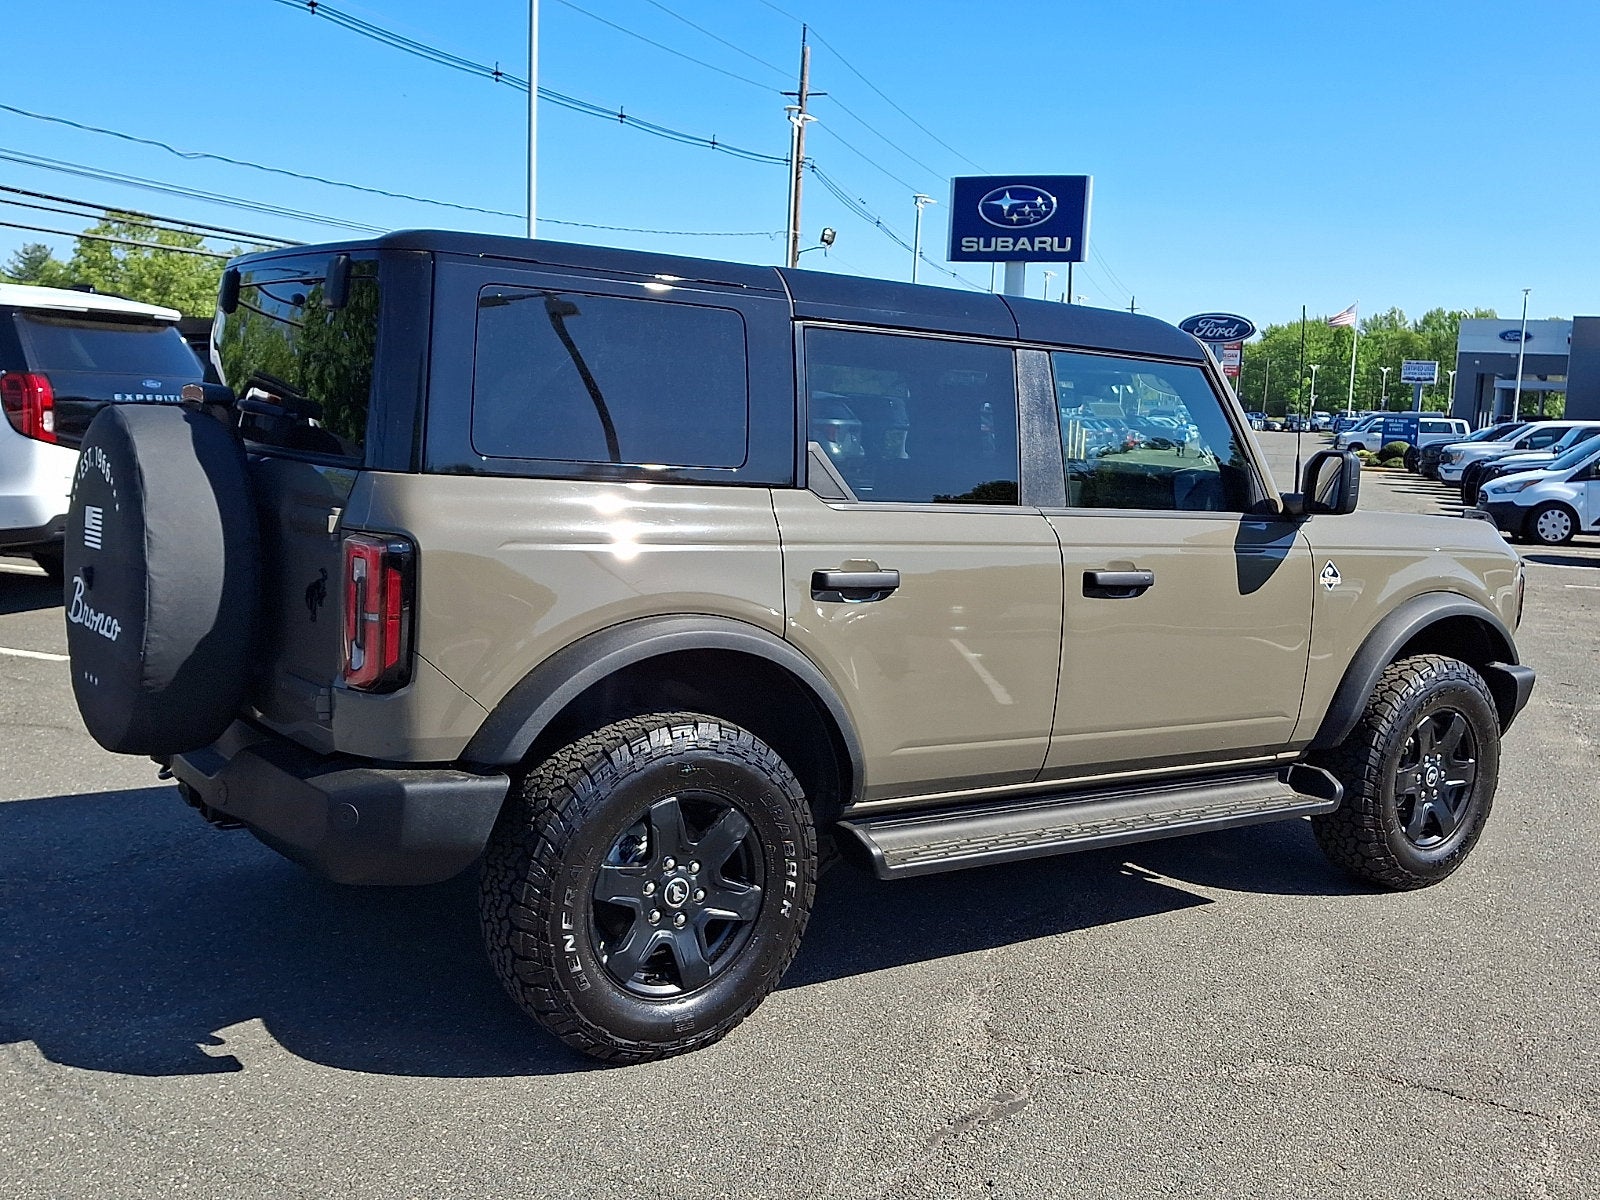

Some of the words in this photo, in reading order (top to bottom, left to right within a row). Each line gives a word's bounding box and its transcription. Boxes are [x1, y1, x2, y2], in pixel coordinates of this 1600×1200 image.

[961, 236, 1072, 253] SUBARU
[1193, 318, 1240, 338] Ford
[113, 393, 181, 401] EXPEDITI
[95, 446, 111, 483] 1966
[67, 576, 121, 641] Bronco
